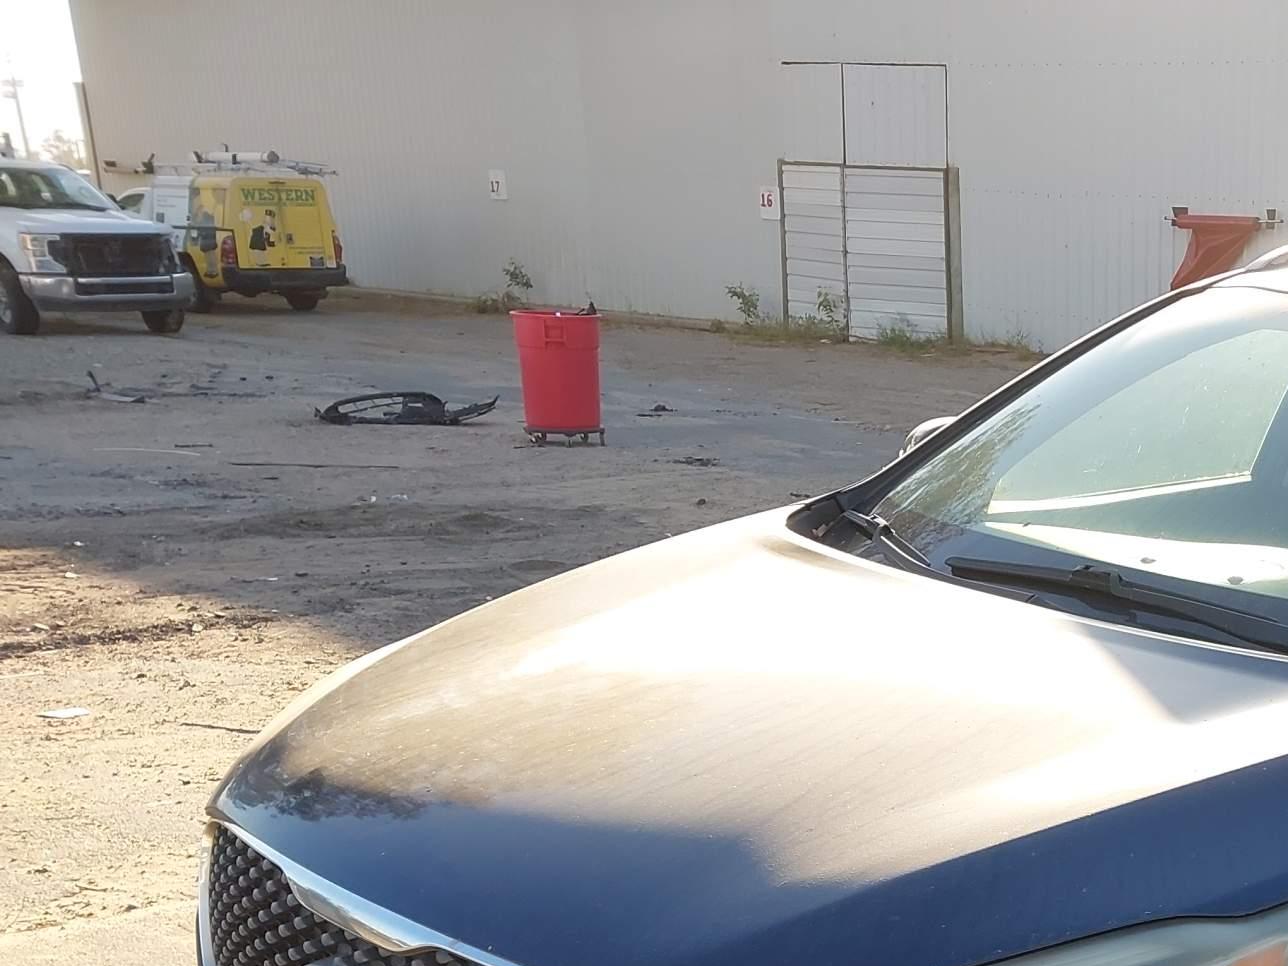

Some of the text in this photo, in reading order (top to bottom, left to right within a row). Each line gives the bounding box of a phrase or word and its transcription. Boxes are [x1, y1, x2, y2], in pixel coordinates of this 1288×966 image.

[490, 180, 500, 193] 17
[240, 187, 316, 202] WESTERN
[760, 192, 773, 208] 16
